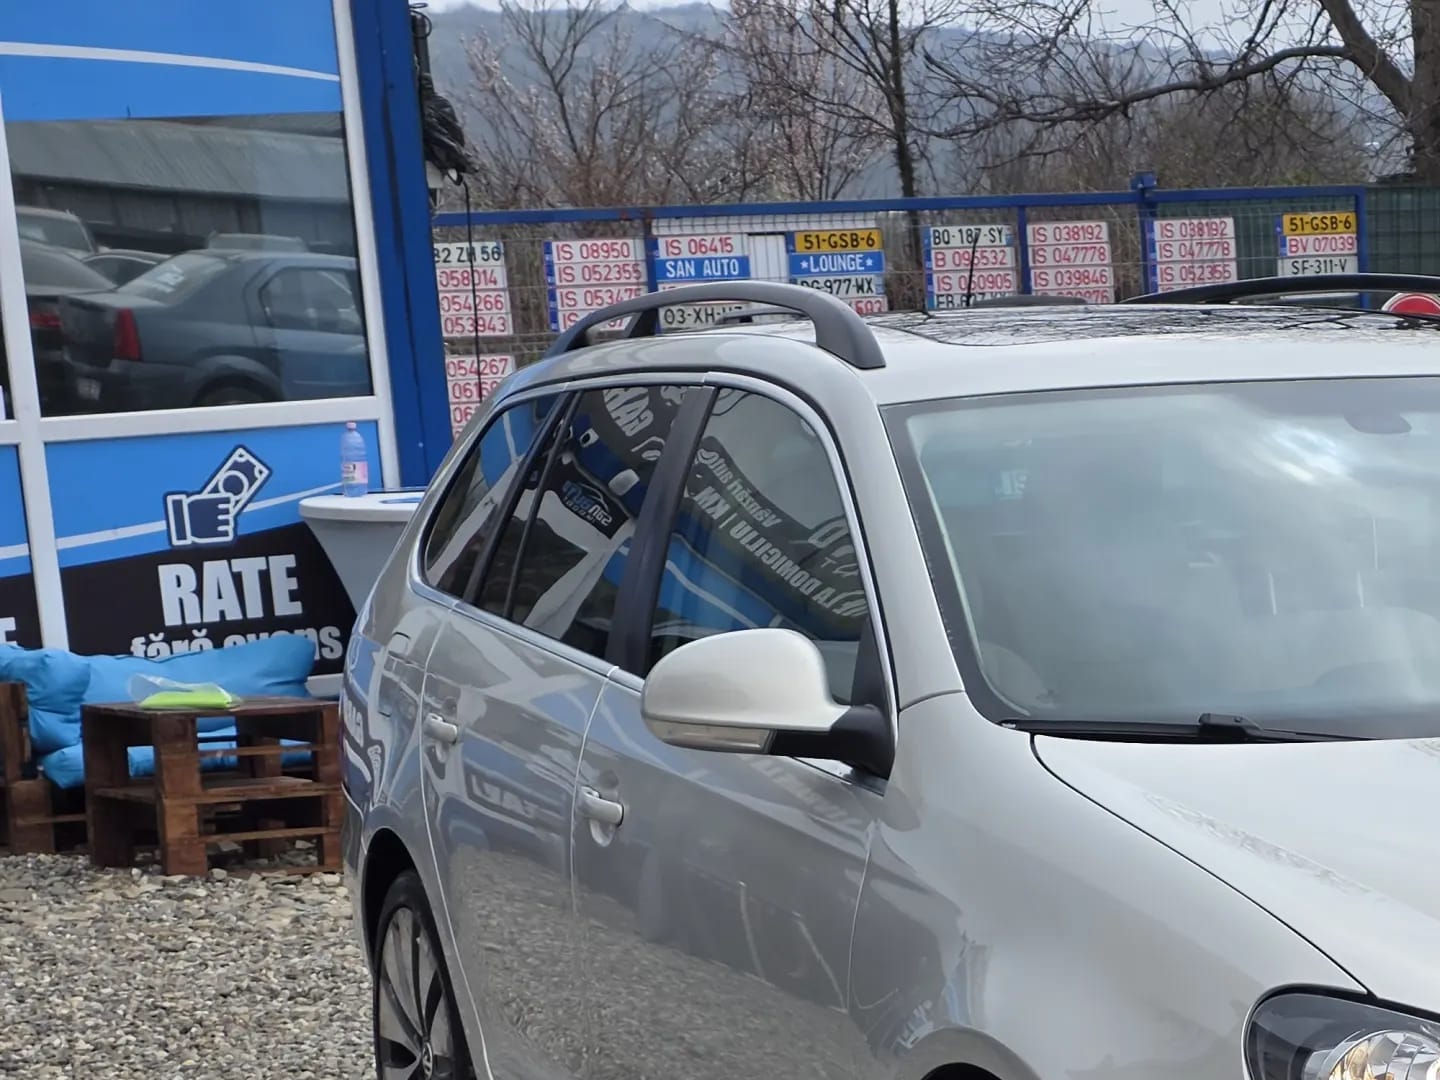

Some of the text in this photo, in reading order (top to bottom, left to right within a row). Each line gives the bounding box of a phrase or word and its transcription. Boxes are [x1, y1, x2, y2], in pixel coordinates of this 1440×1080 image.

[1160, 223, 1174, 239] IS
[1289, 215, 1352, 232] 51-GSB-6
[804, 231, 876, 250] 51-GSB-6
[1032, 224, 1104, 243] IS 038192
[481, 245, 502, 262] 56
[556, 241, 631, 261] IS 08950
[665, 236, 734, 257] IS 06415
[1159, 243, 1174, 260] IS
[1288, 235, 1355, 254] BV 07039
[809, 254, 865, 273] LOUNGE
[934, 251, 946, 268] B
[1032, 246, 1106, 265] IS 047778
[558, 265, 576, 283] IS
[665, 258, 740, 278] SAN AUTO
[1160, 266, 1174, 283] IS
[937, 275, 953, 292] IS
[1034, 268, 1108, 288] IS 039846
[560, 290, 577, 308] IS
[664, 306, 743, 325] 03-XH-
[157, 554, 303, 627] RATE
